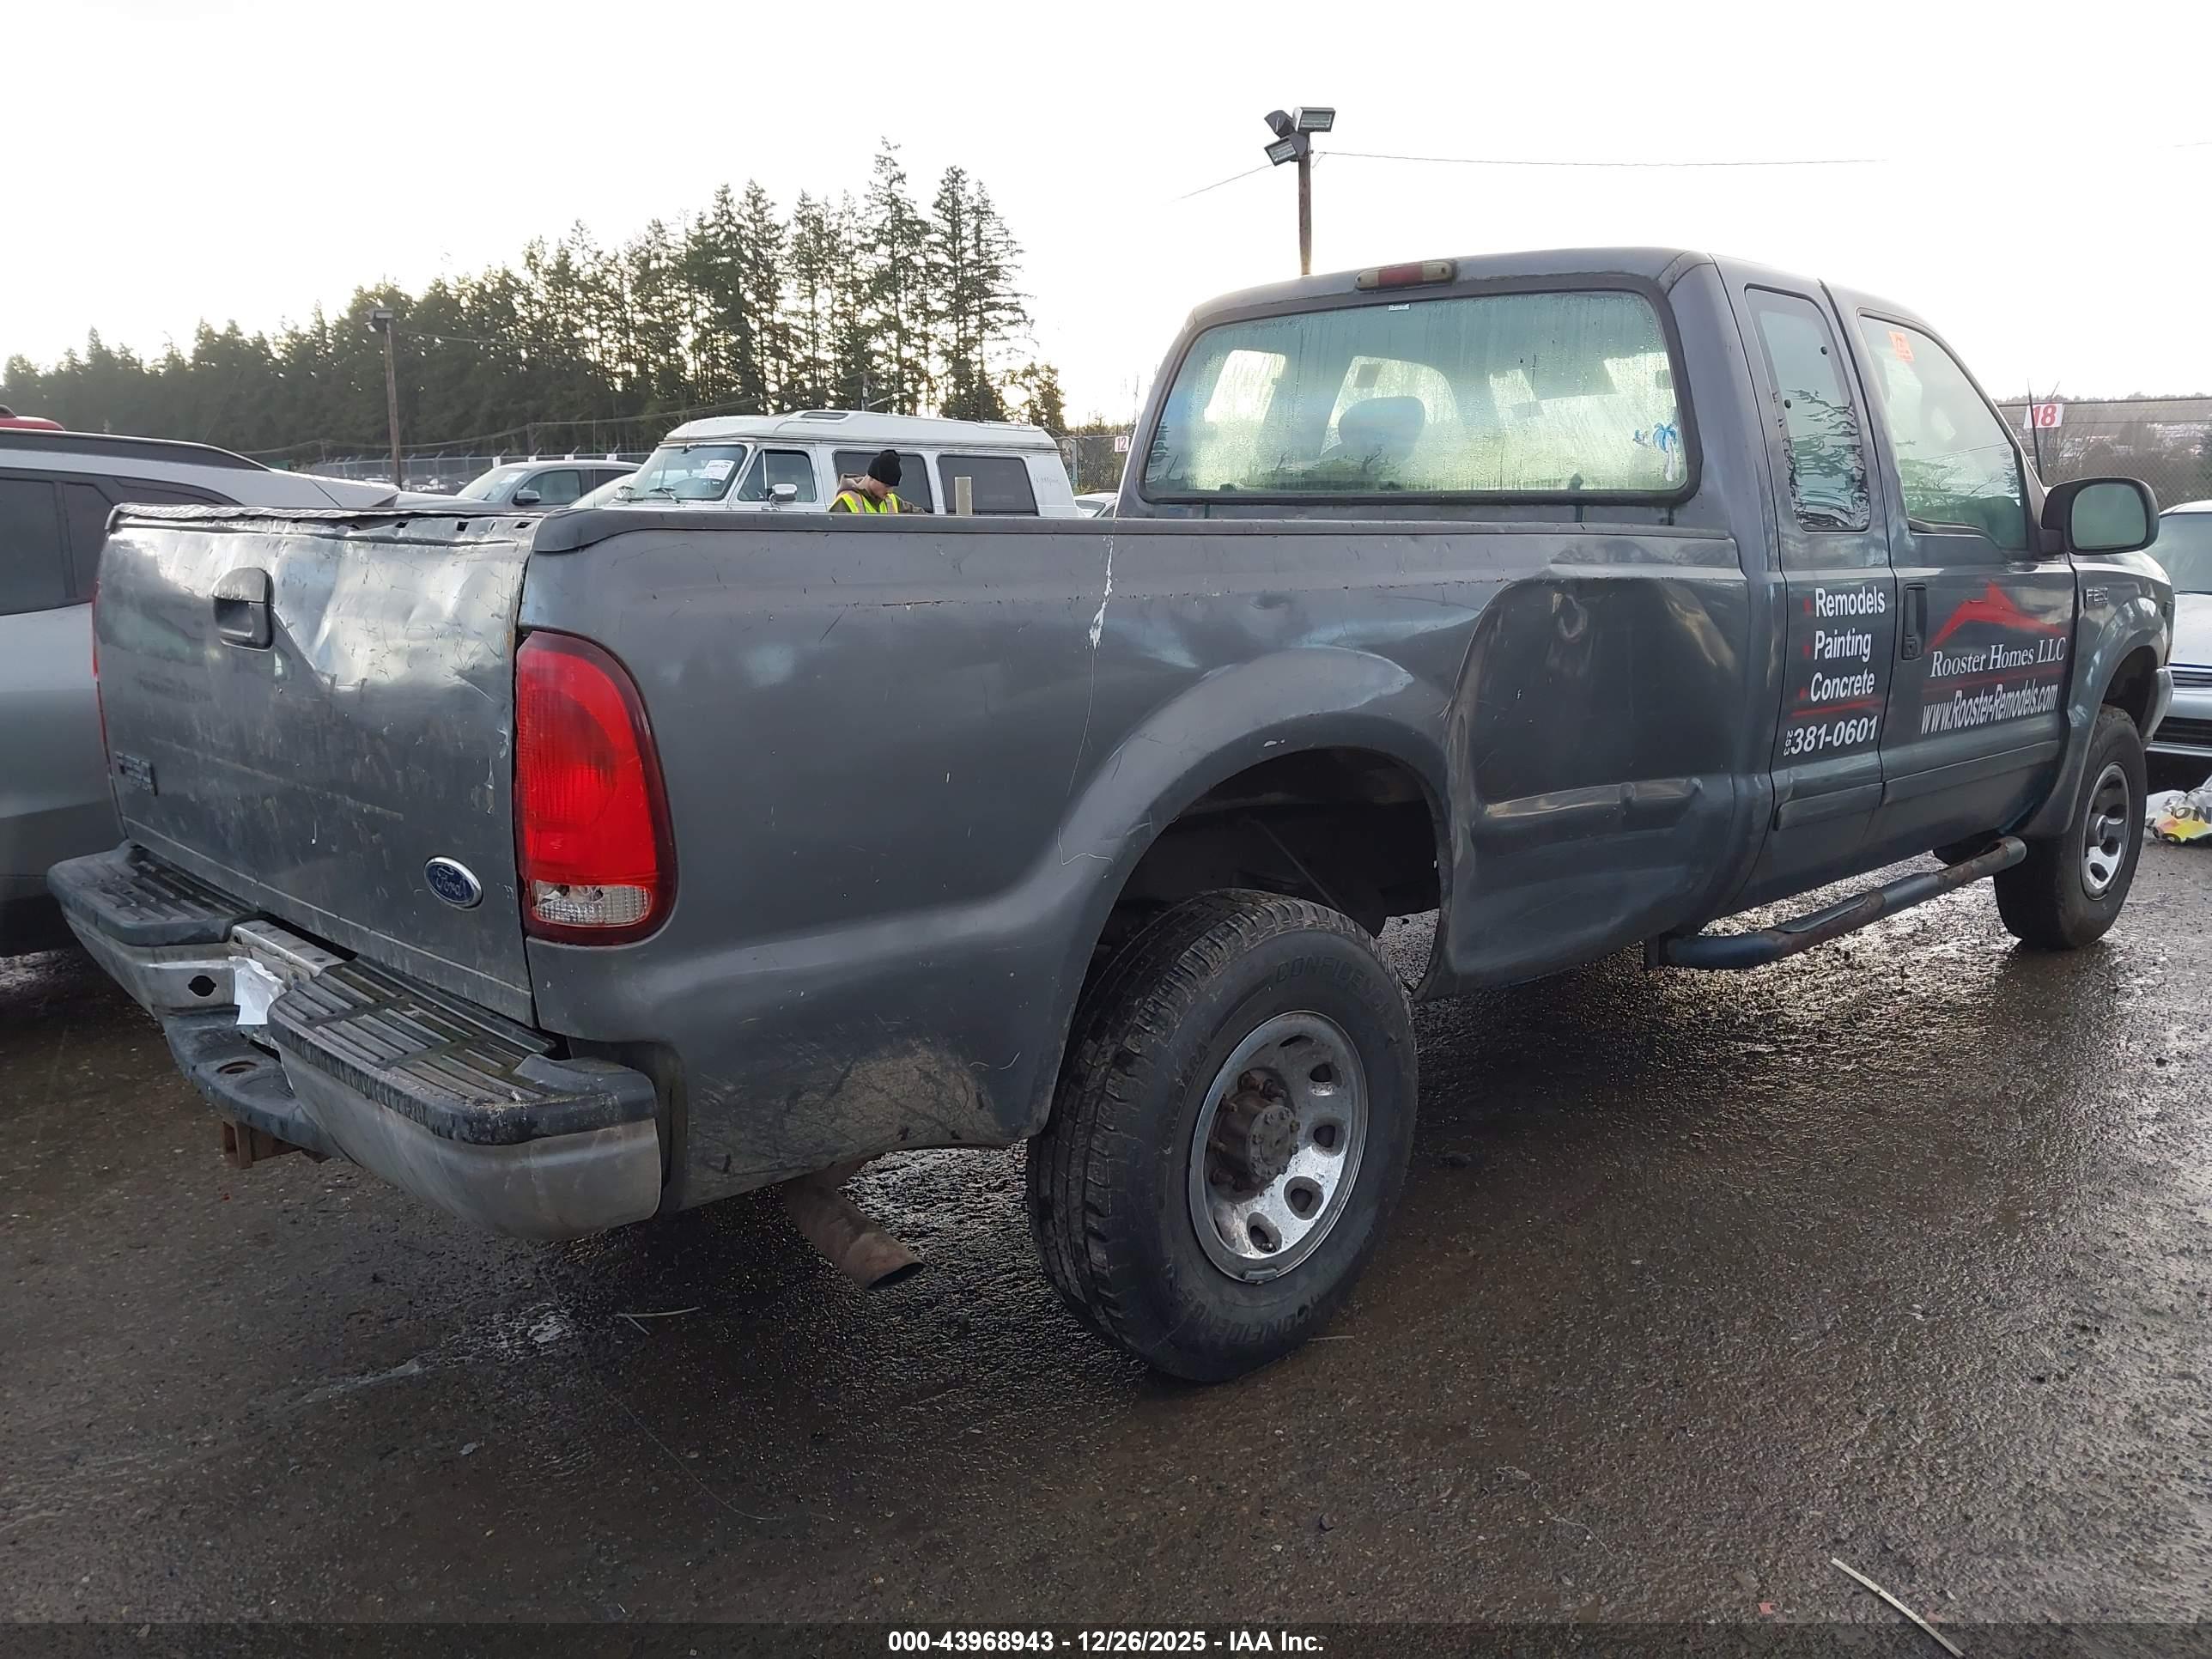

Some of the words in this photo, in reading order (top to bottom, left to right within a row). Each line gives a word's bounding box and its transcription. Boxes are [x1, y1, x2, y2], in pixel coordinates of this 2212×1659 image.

[2033, 404, 2057, 427] 18
[1117, 437, 1127, 451] 12
[1815, 586, 1885, 617] Remodels
[1814, 628, 1871, 662] Painting
[1930, 651, 1986, 678] Rooster
[1988, 644, 2034, 670] Homes
[2037, 637, 2066, 663] LLC
[1810, 667, 1875, 702] Concrete
[1921, 678, 2058, 735] www.Rooster-Remodels.com
[1791, 715, 1878, 754] 381-0601
[435, 867, 467, 898] Ford
